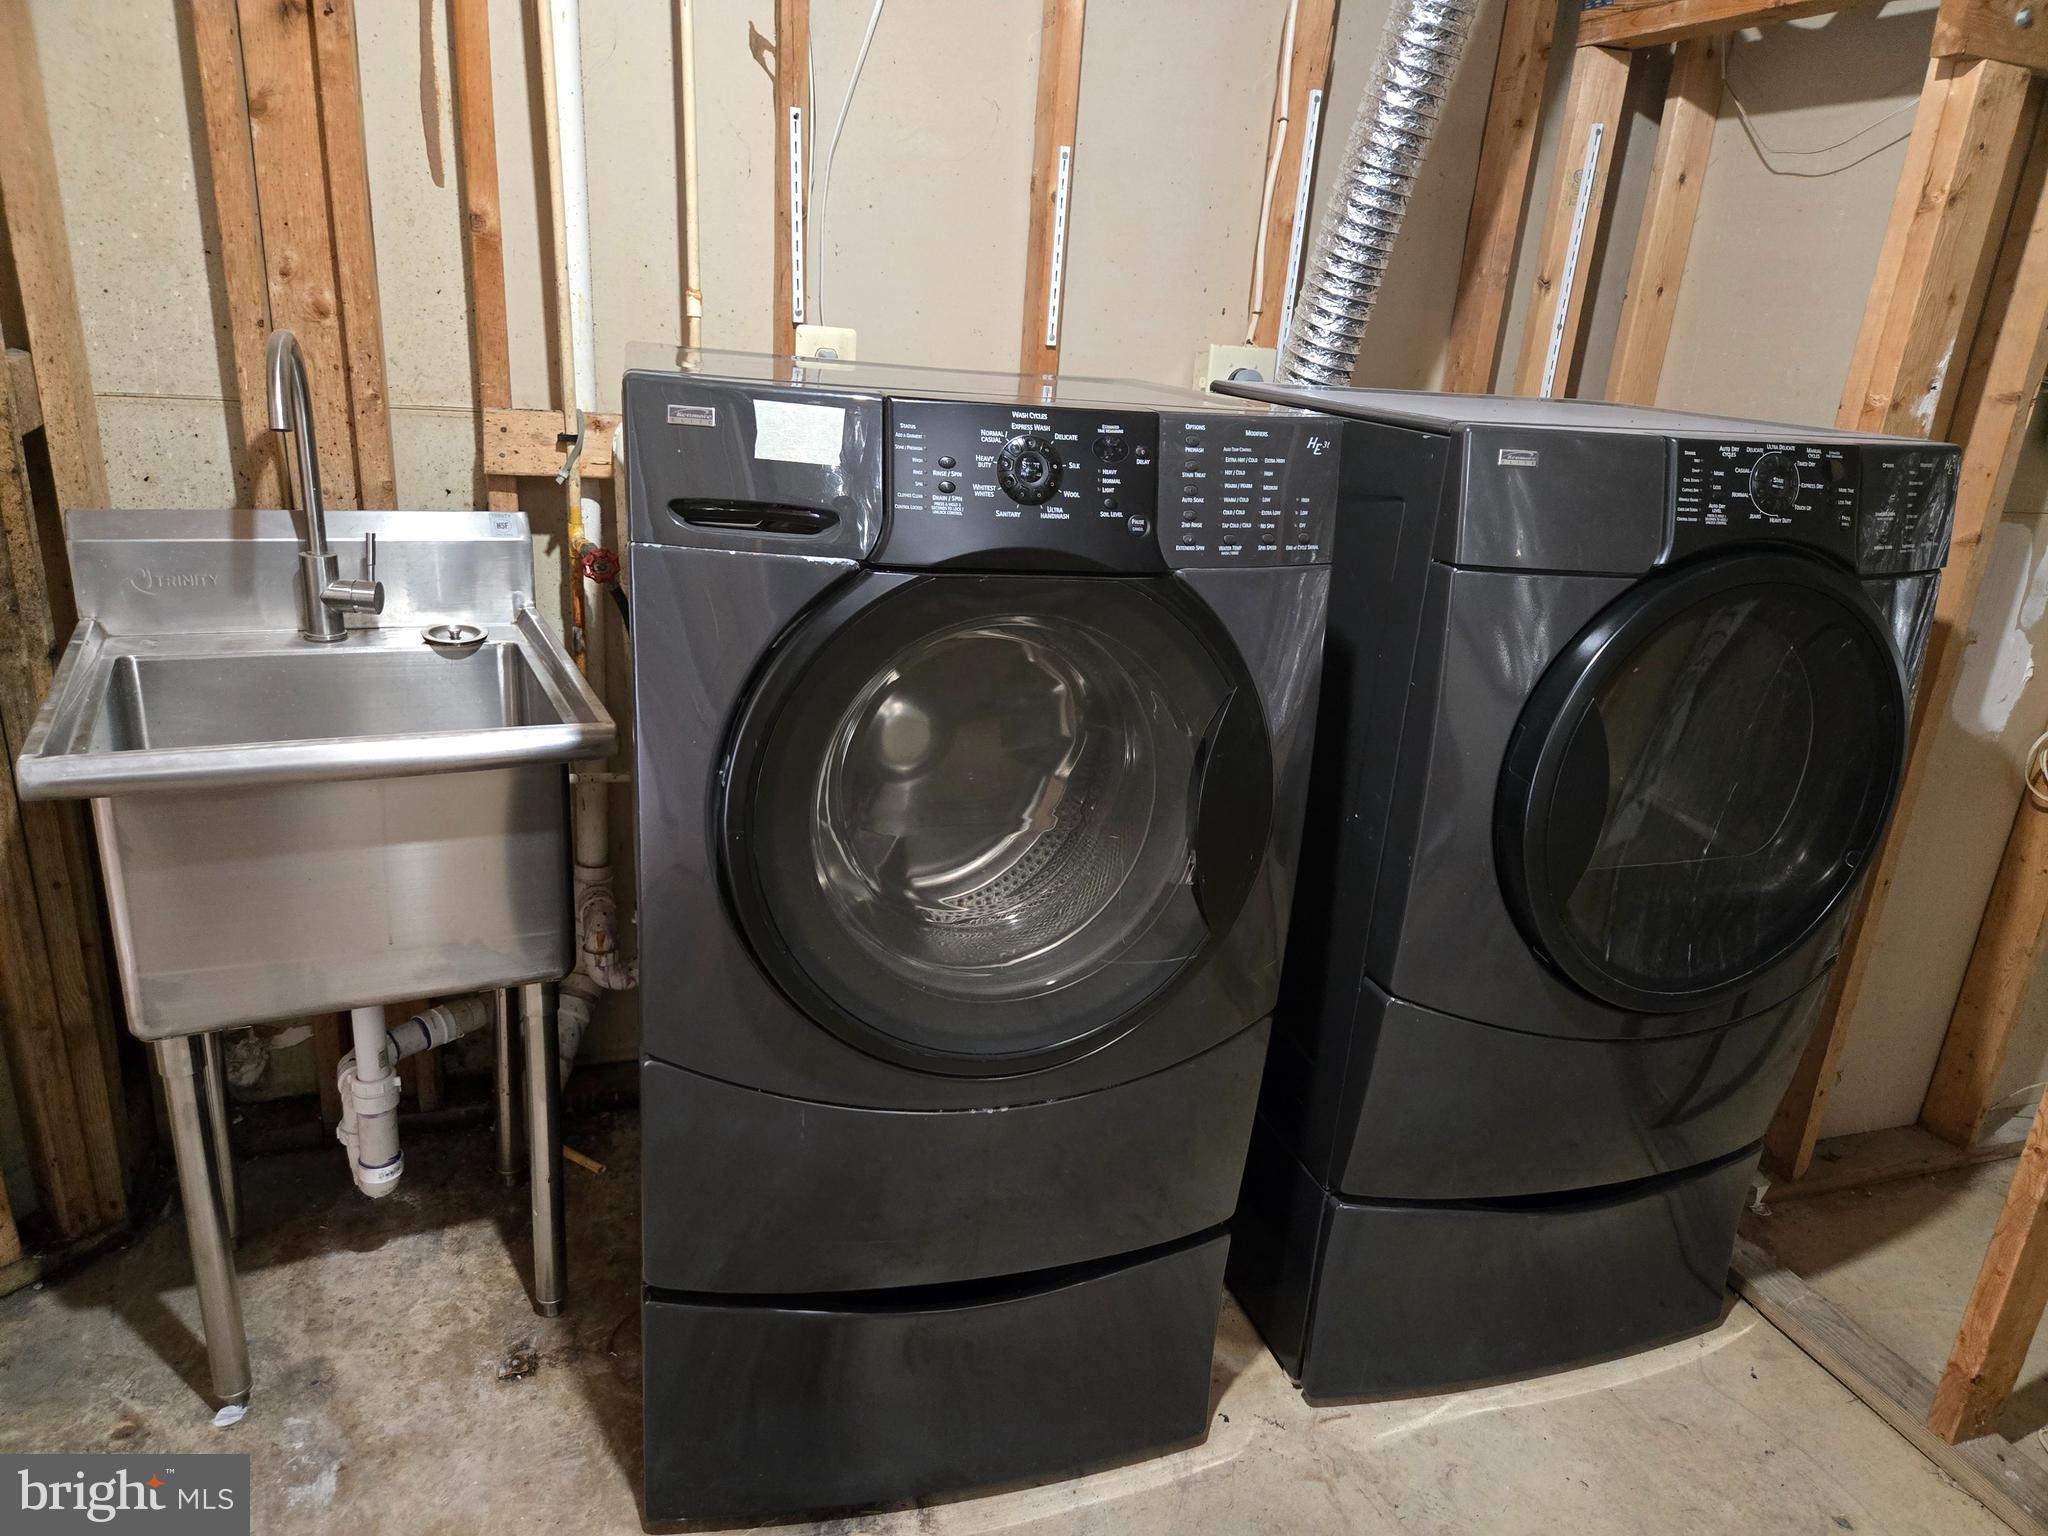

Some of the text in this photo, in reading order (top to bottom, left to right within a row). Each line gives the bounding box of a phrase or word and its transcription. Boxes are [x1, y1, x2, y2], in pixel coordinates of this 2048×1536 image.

[1030, 412, 1047, 420] CYCLES
[1055, 433, 1078, 441] DELICATE
[996, 510, 1021, 518] SANITARY
[156, 575, 217, 587] TRINITY
